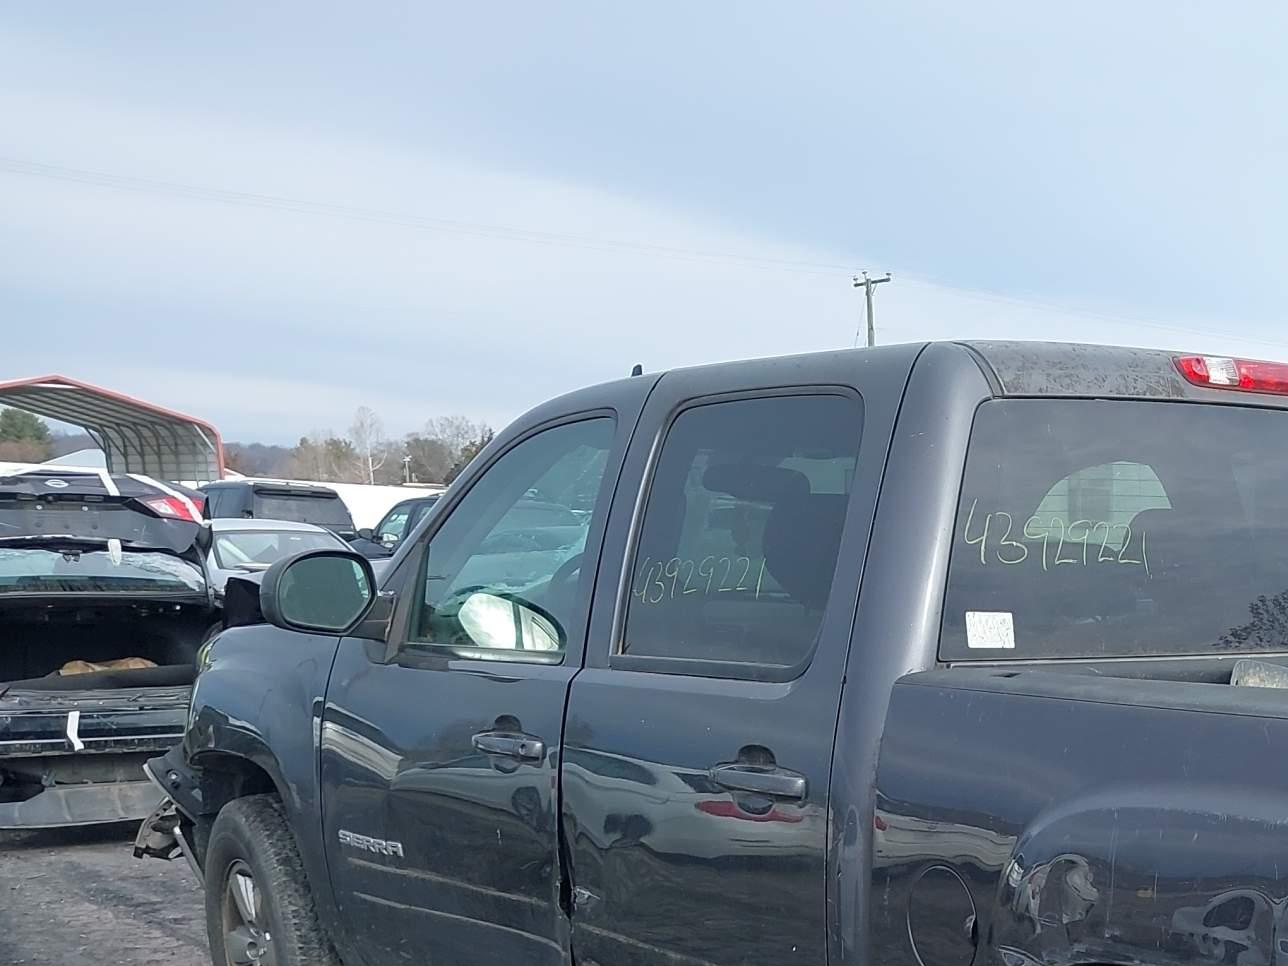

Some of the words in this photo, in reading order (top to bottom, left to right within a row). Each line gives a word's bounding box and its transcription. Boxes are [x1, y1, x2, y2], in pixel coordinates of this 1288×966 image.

[964, 498, 1152, 580] 43929221
[632, 555, 767, 604] 43929221
[338, 829, 405, 858] SIERRA
